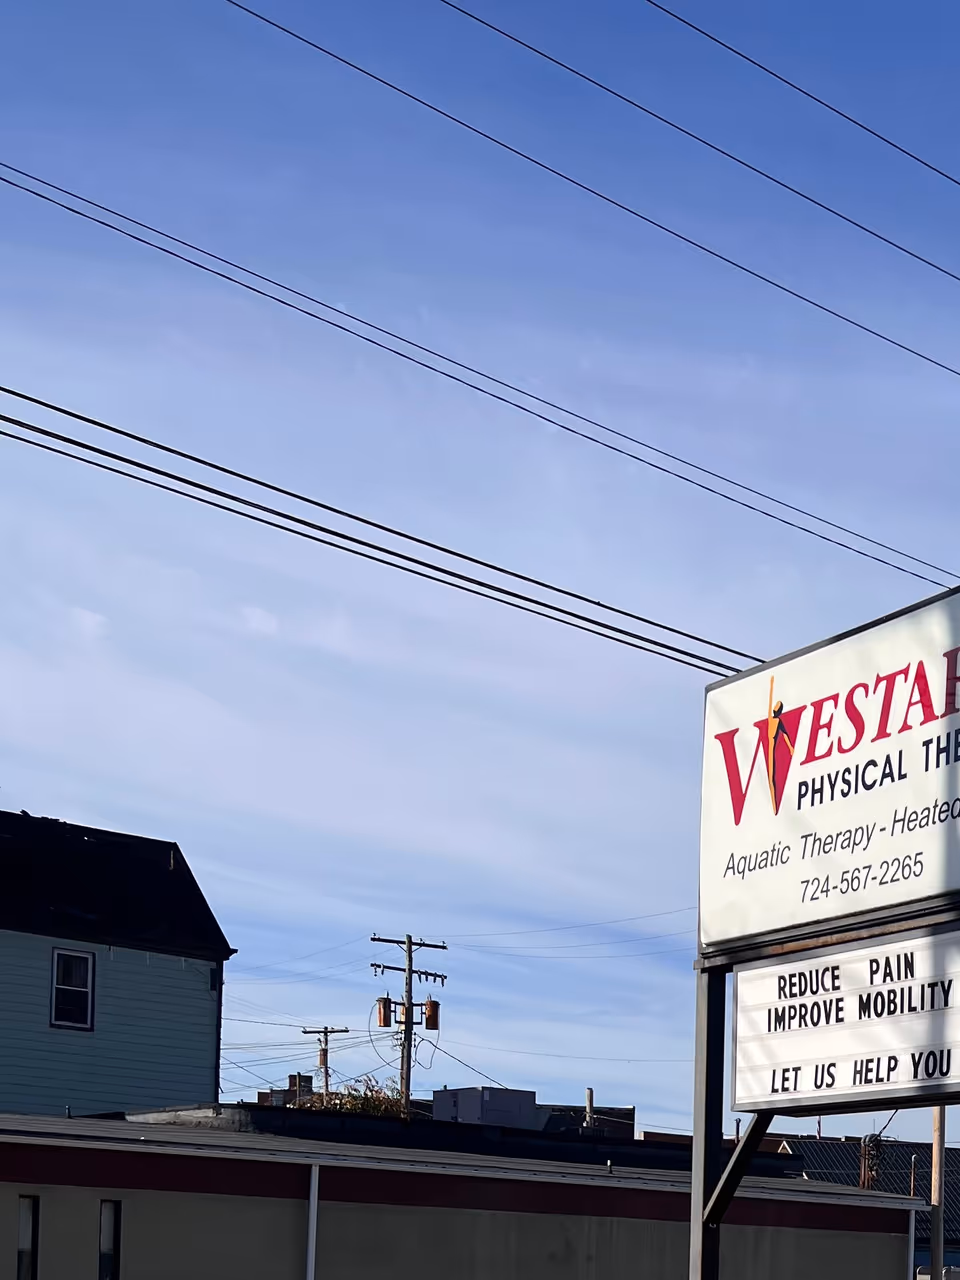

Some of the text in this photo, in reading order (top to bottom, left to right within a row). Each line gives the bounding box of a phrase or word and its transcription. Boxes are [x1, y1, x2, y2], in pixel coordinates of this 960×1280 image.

[797, 749, 908, 810] PHYSICAL
[723, 841, 791, 879] Aquatic
[800, 822, 875, 862] Therapy
[800, 852, 924, 903] 724-567-2265
[778, 952, 915, 999] REDUCE PAIN
[767, 979, 953, 1033] IMPROVE MOBILITY
[771, 1049, 951, 1093] LET US HELP YOU
